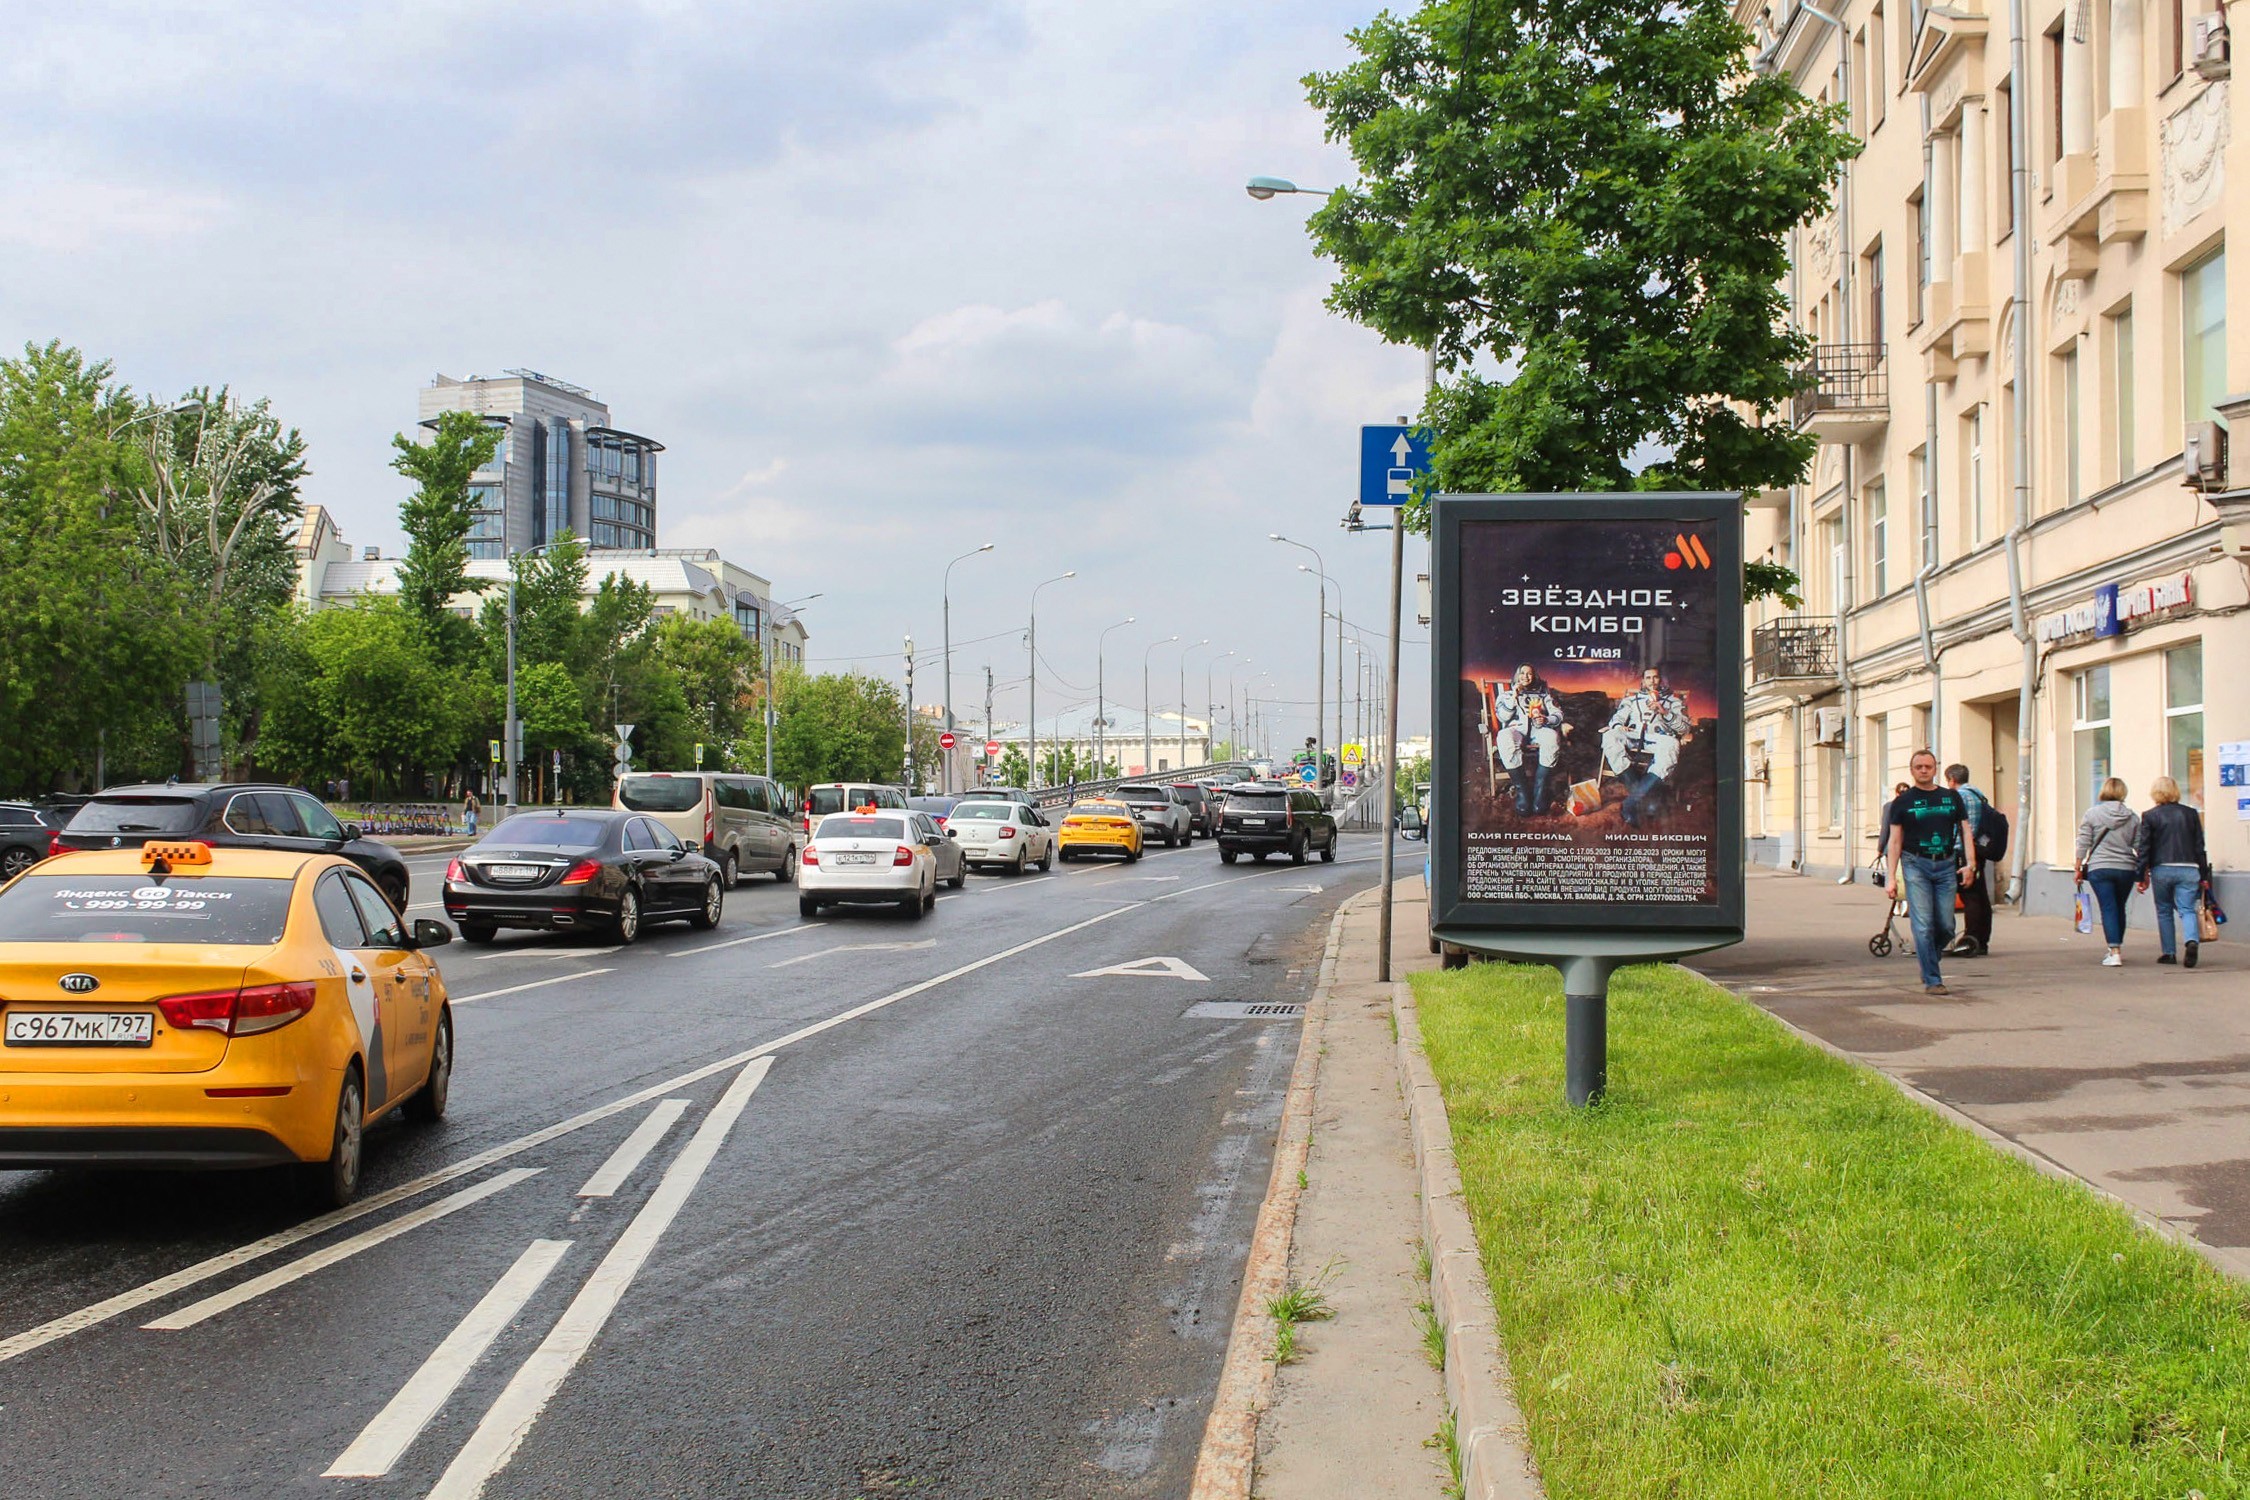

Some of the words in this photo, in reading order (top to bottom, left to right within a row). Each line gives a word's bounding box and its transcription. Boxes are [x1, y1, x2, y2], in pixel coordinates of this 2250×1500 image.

[1502, 584, 1672, 608] ЗВЁЗДНОЕ
[1530, 616, 1642, 633] КОМБО
[1554, 648, 1562, 658] с
[1566, 646, 1586, 658] 17
[1590, 648, 1621, 659] мая
[1504, 833, 1572, 841] ПЕРЕСИЛЬД
[1516, 846, 1567, 855] ДЕЙСТВИТЕЛЬНО
[54, 889, 130, 898] Яндекс
[174, 889, 234, 899] Такси
[84, 900, 206, 910] 999-99-99
[65, 978, 93, 990] KIA
[111, 1016, 145, 1033] 797
